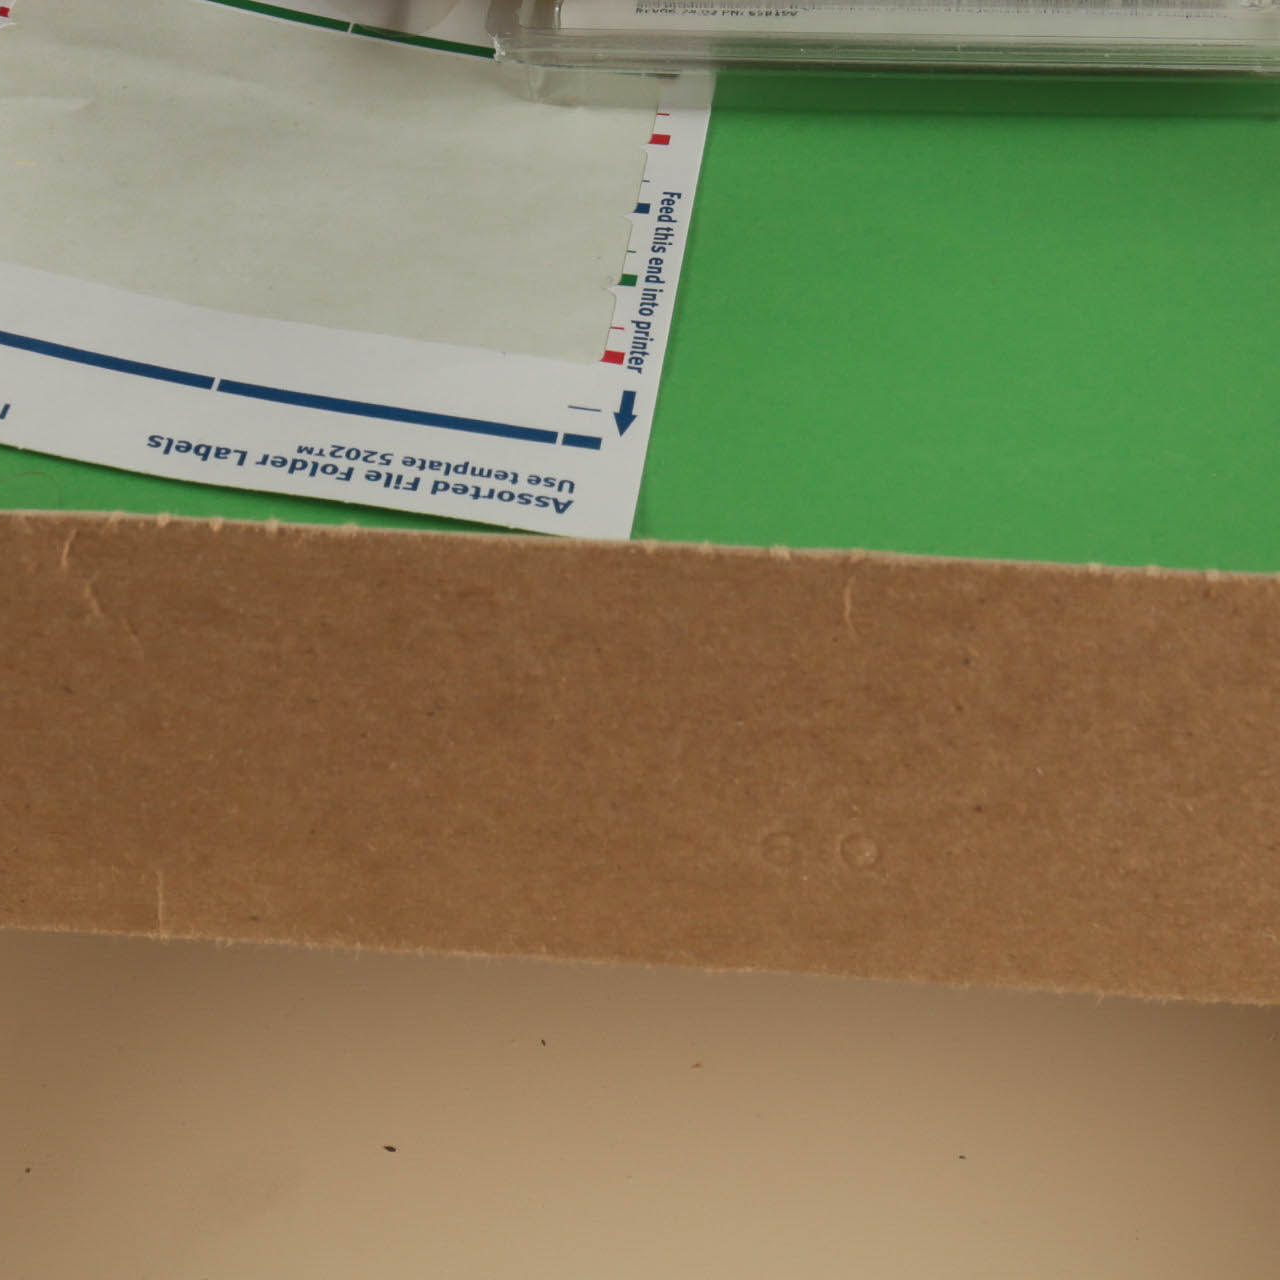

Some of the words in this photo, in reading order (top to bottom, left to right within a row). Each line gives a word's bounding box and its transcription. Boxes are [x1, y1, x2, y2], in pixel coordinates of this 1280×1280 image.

[656, 191, 681, 223] Feed
[651, 226, 675, 254] this
[644, 257, 665, 284] end
[638, 287, 663, 317] into
[628, 319, 654, 374] printer
[147, 432, 247, 466] Labels
[255, 450, 352, 482] Folder
[365, 469, 420, 492] File
[401, 455, 519, 486] template
[431, 478, 574, 515] Assorted
[527, 473, 575, 492] Use
